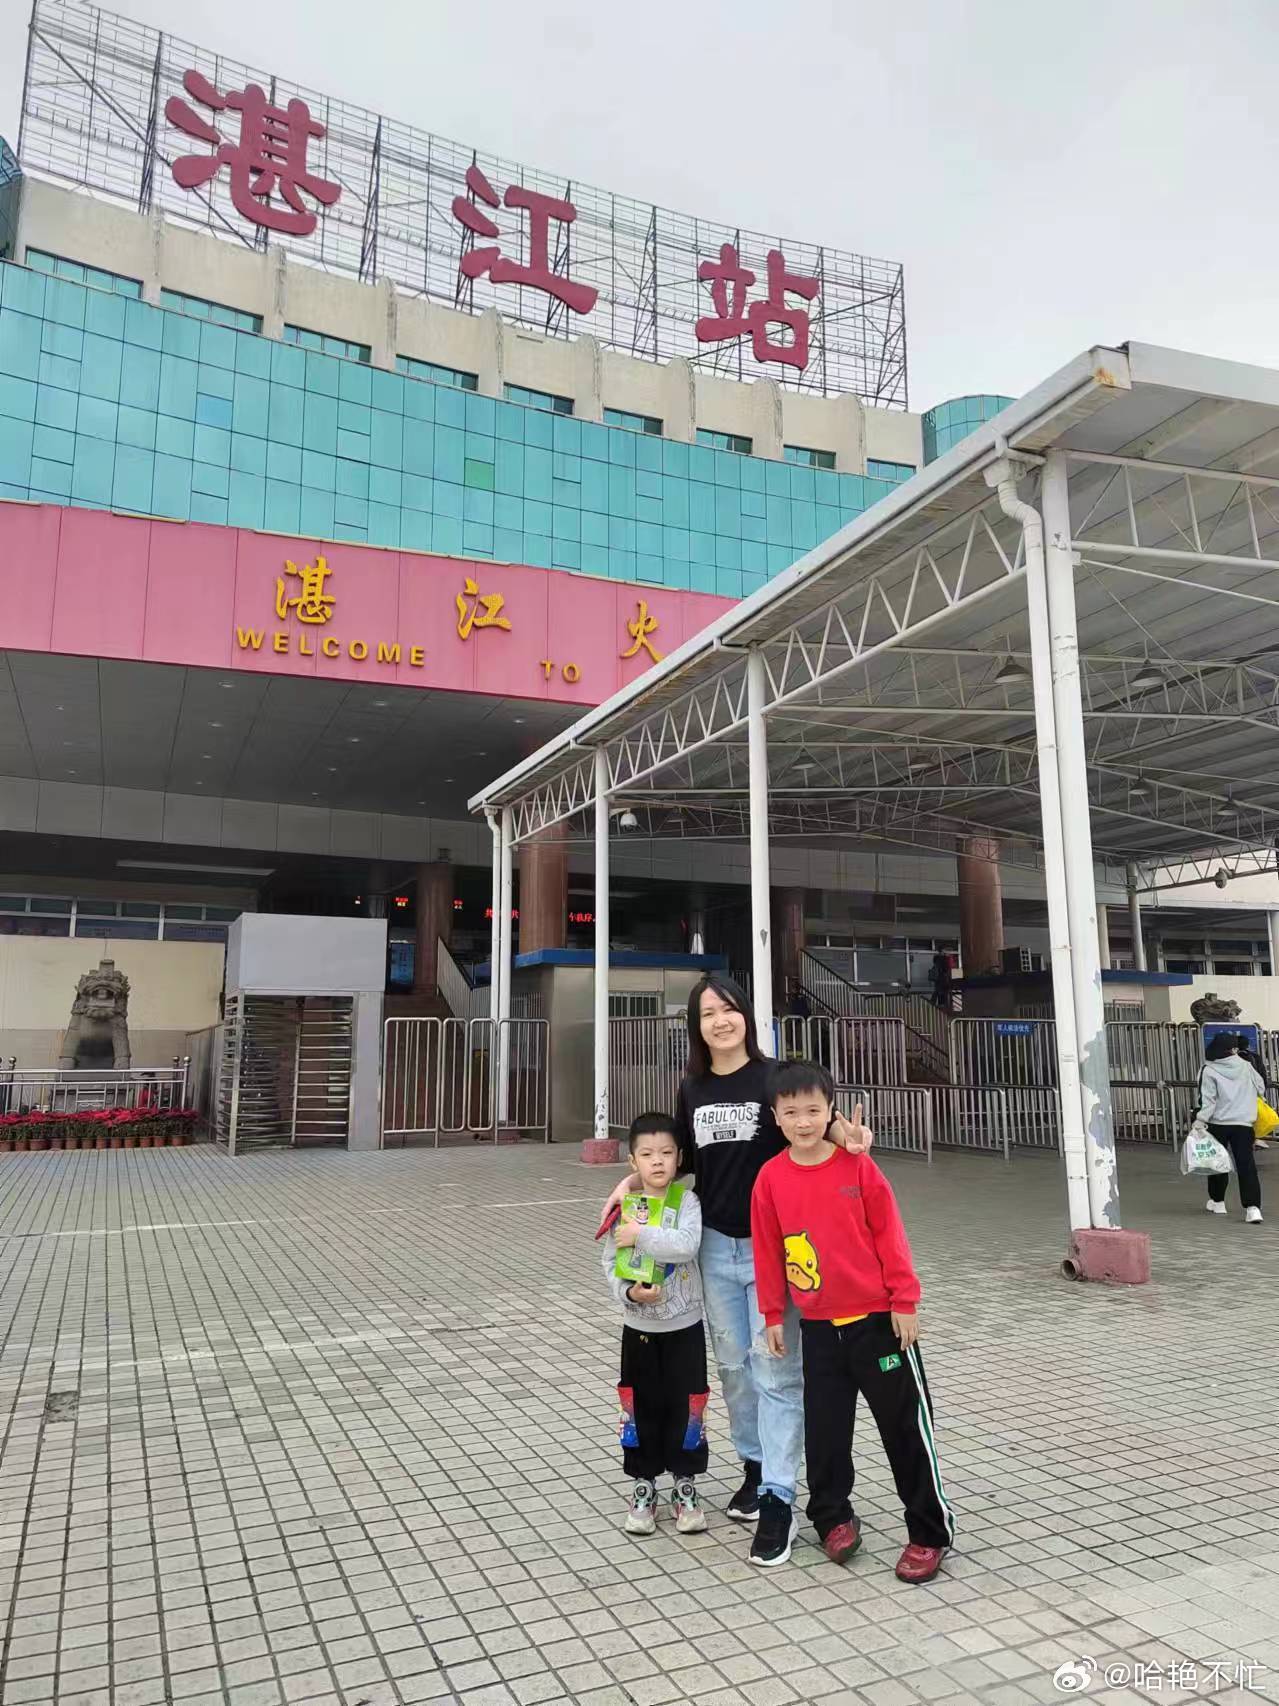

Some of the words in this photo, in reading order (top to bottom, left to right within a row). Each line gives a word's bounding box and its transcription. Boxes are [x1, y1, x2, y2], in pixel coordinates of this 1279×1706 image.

[165, 69, 819, 371] 湛江站
[237, 627, 426, 667] WELCOME
[540, 659, 581, 684] TO
[696, 1106, 754, 1127] FABULOUS
[715, 1130, 735, 1140] MYSELF
